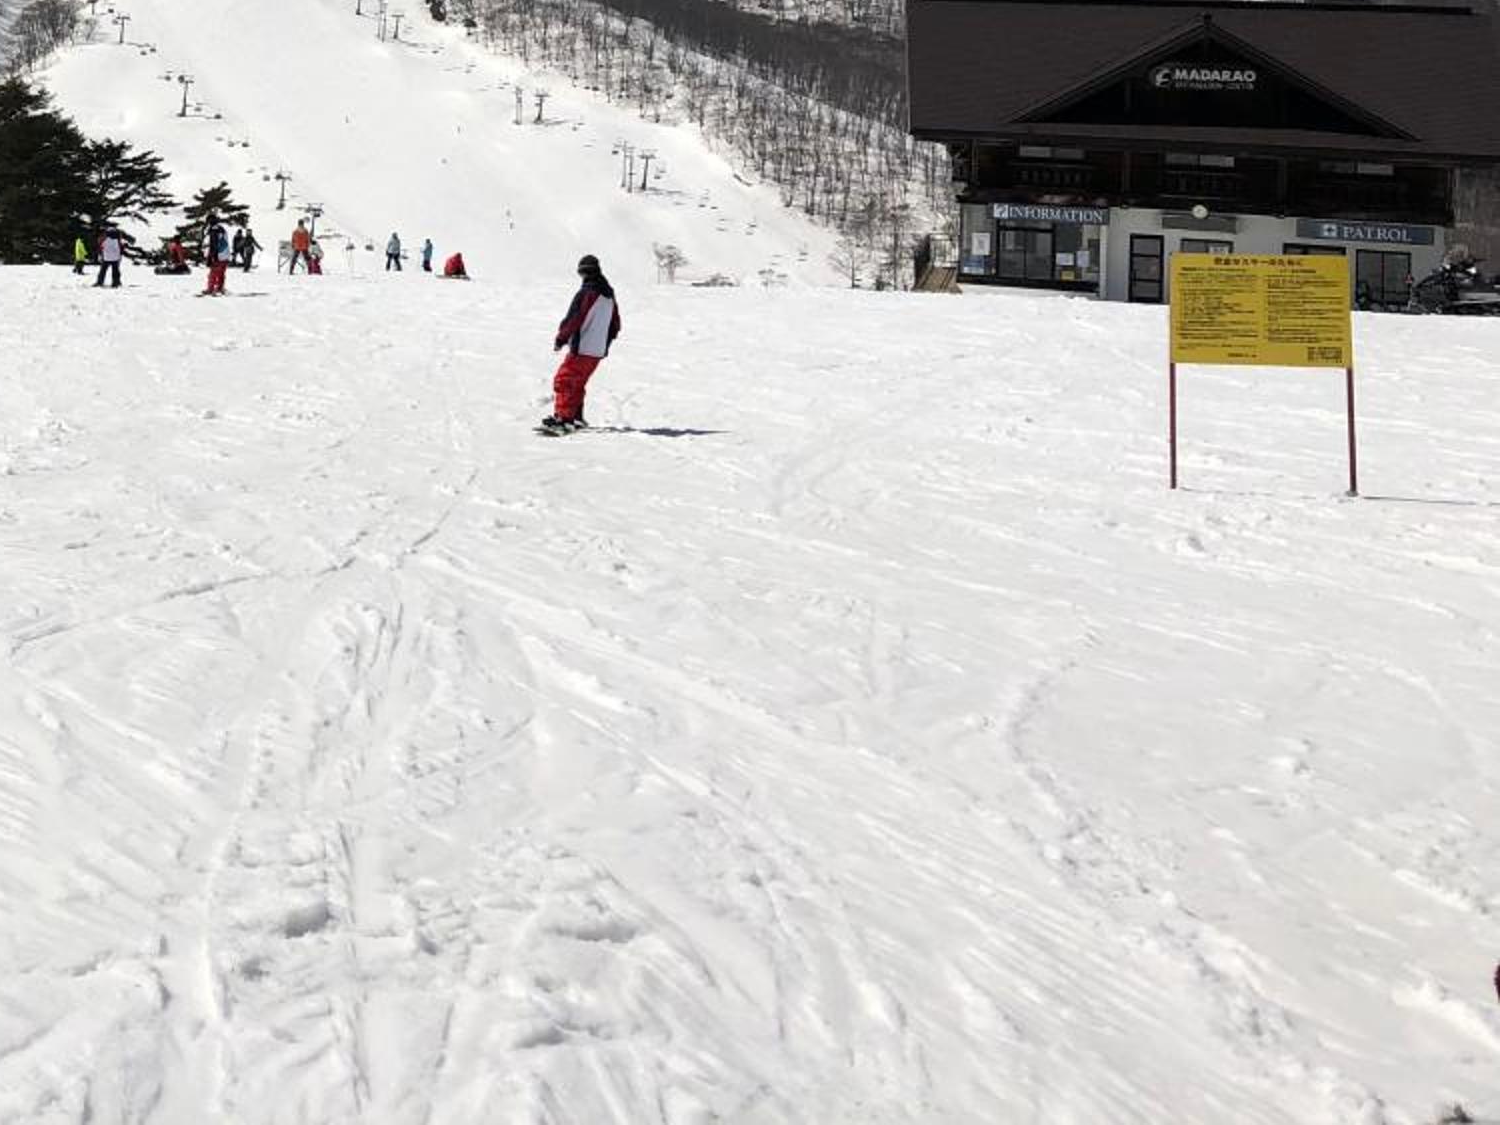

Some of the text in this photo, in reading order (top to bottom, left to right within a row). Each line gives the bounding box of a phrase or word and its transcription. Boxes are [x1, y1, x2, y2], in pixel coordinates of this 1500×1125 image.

[1174, 68, 1257, 82] MADARAO
[1009, 206, 1103, 223] INFORMATION
[1343, 226, 1413, 242] PATROL
